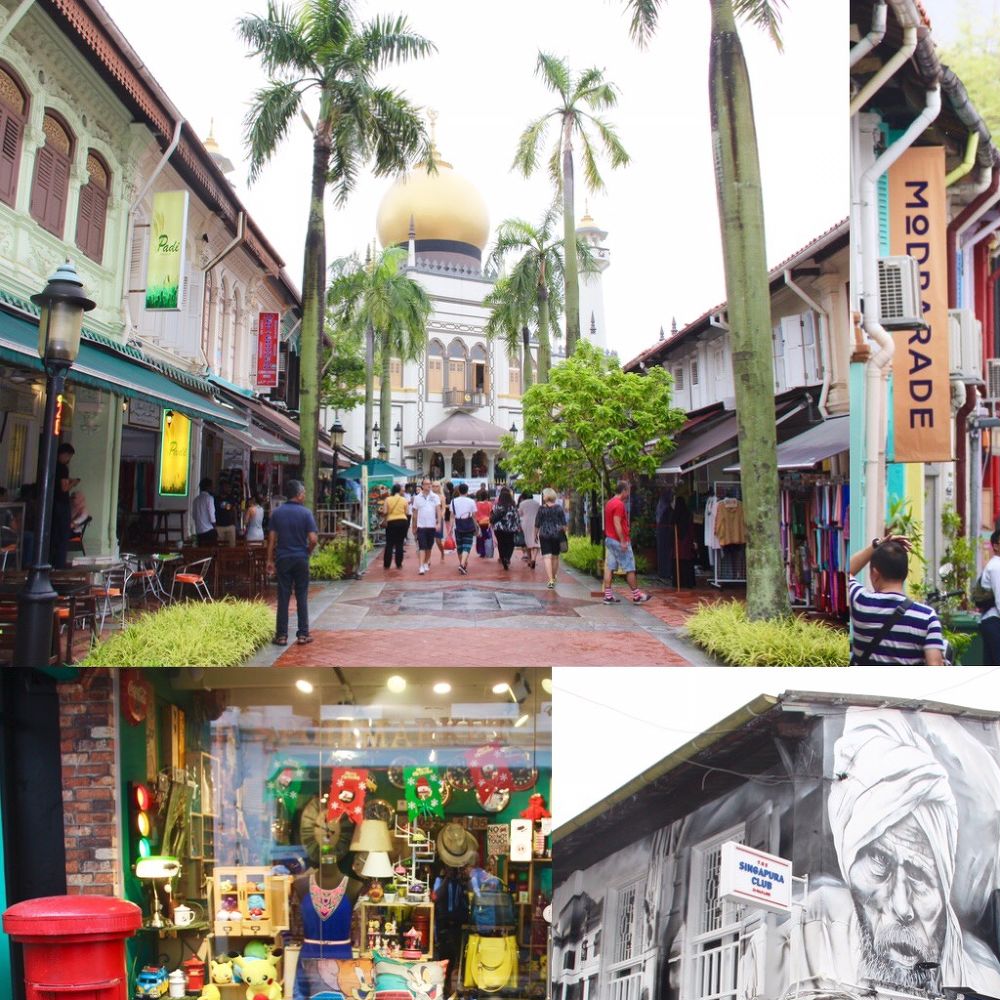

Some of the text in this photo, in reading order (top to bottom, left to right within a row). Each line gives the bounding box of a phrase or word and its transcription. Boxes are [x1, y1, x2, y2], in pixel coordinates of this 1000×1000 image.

[157, 234, 180, 253] Padi
[738, 861, 785, 884] SINGAPURA
[751, 876, 773, 890] CLUB
